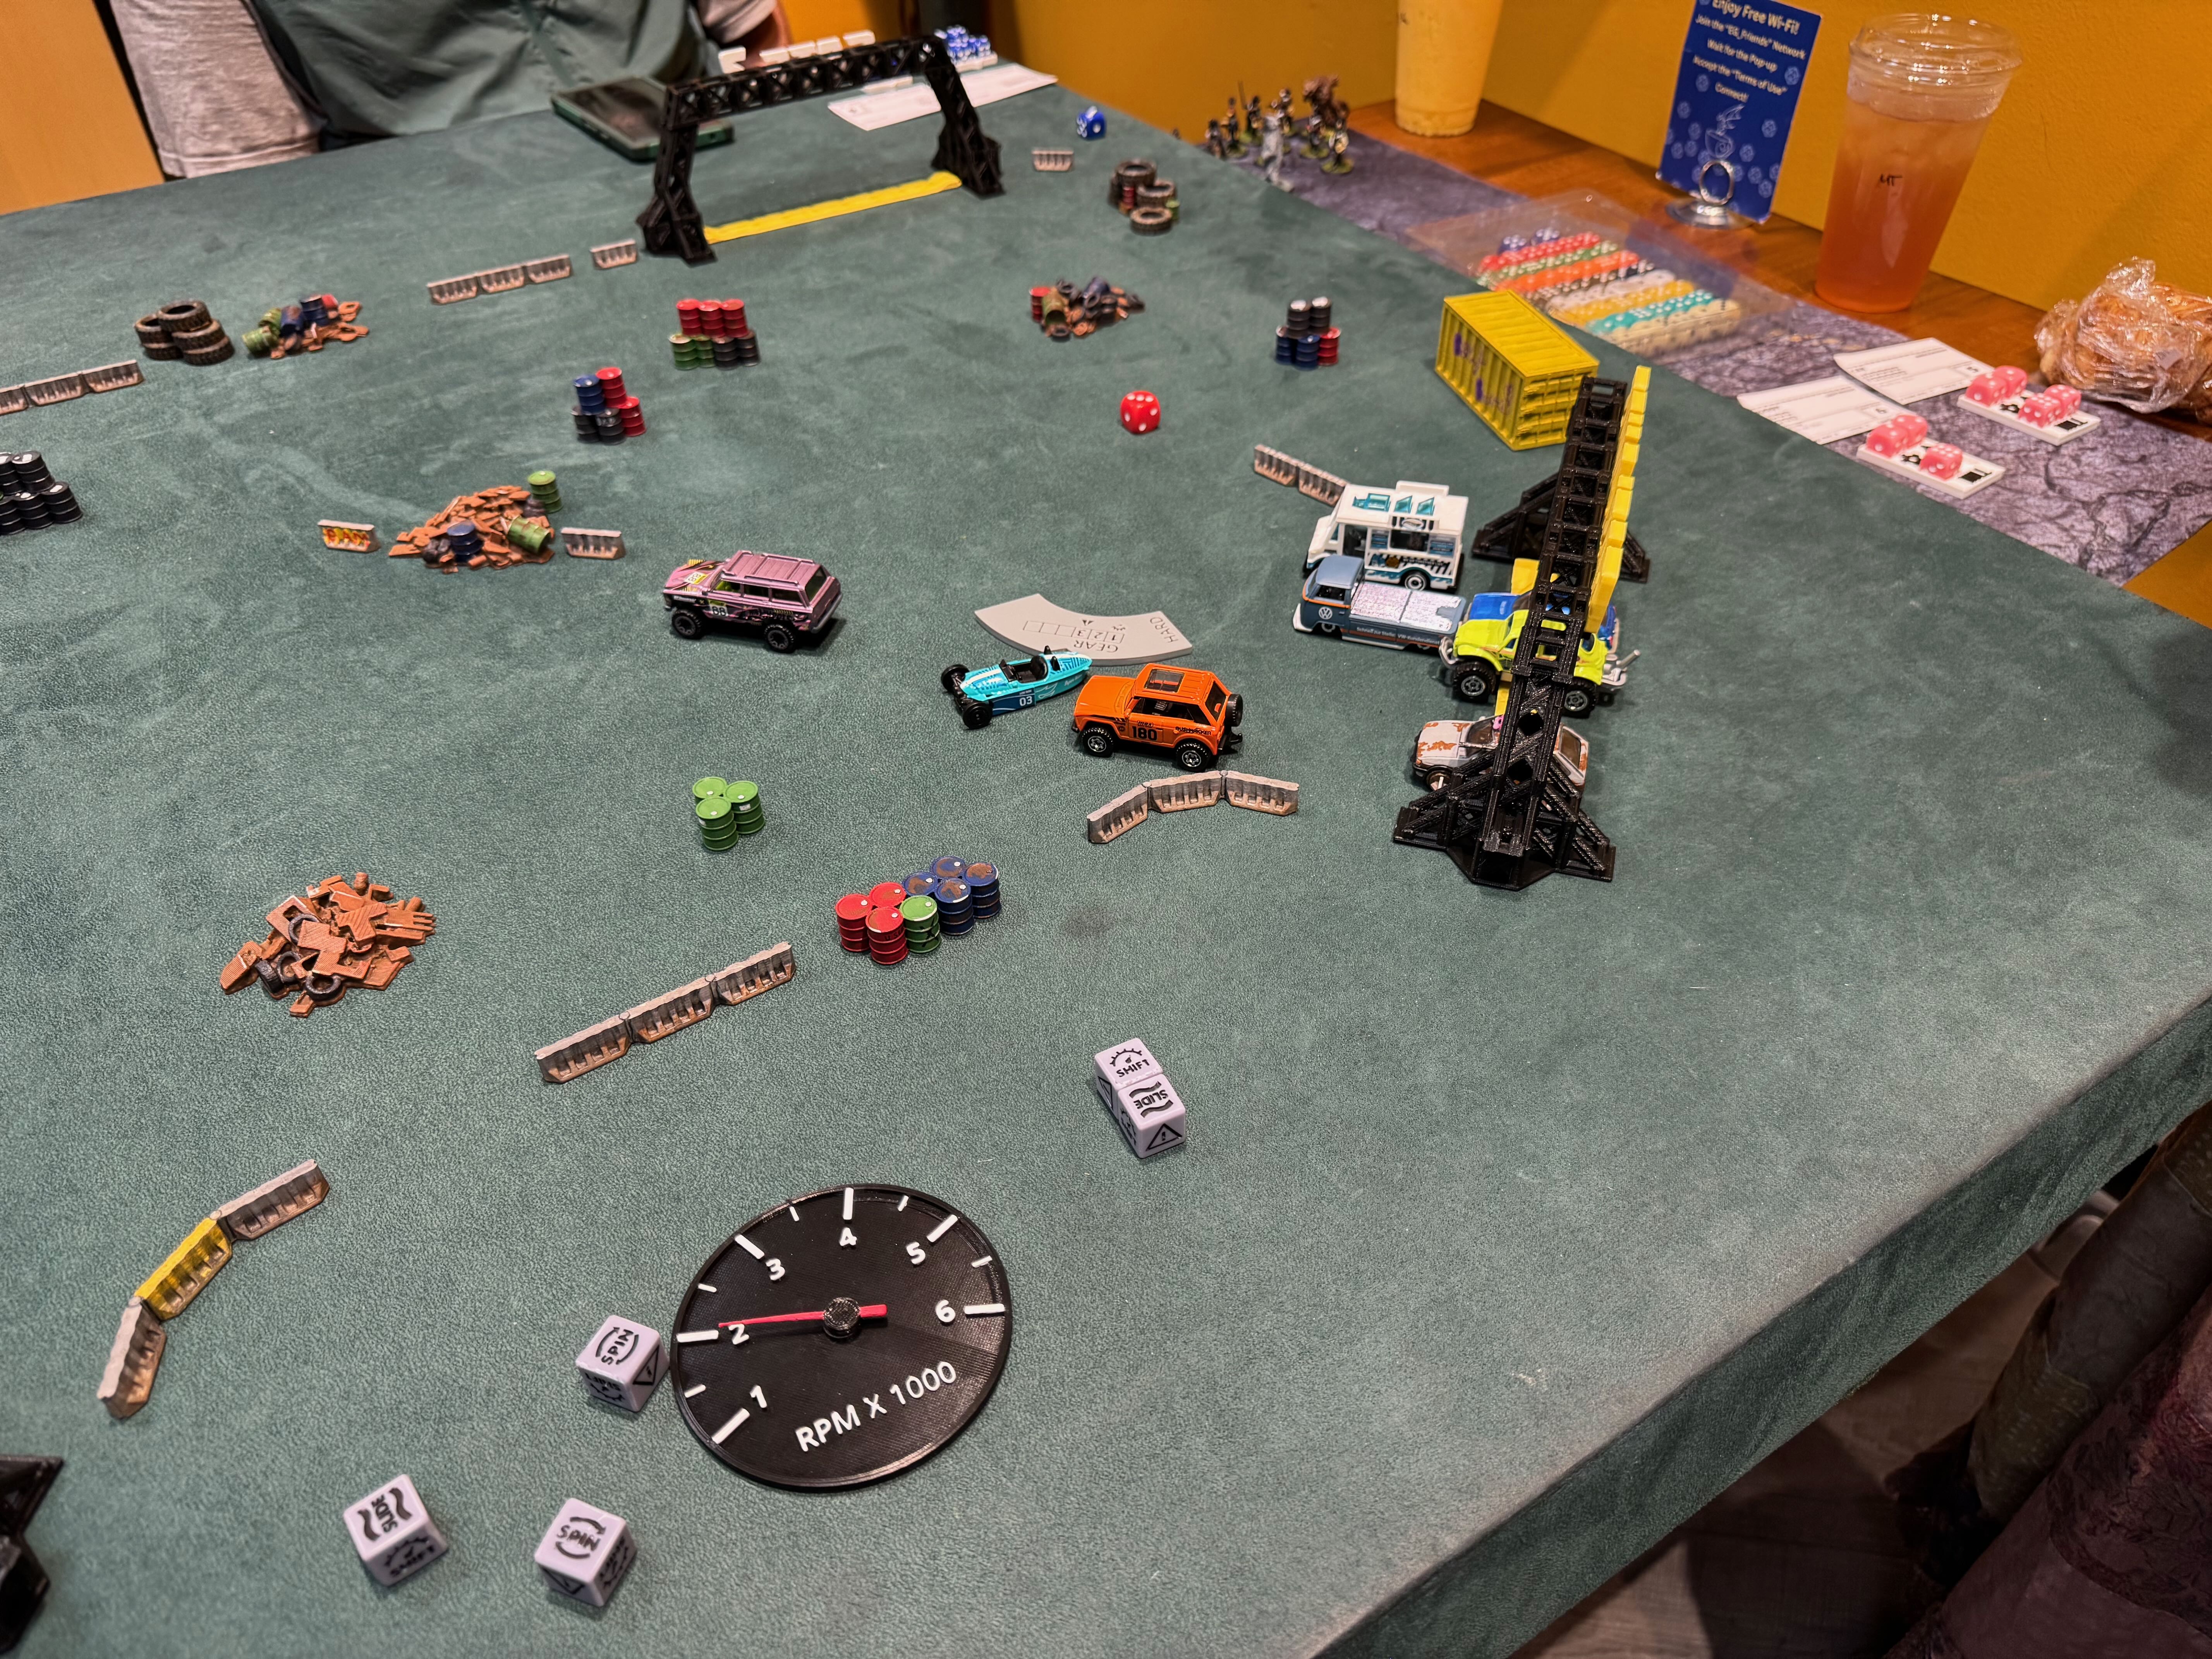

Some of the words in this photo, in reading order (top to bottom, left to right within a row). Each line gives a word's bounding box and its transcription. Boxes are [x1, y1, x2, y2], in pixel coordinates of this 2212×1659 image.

[1712, 0, 1742, 18] Enjoy
[1742, 4, 1767, 24] Free
[1767, 12, 1800, 35] Wi-Fi!
[1695, 14, 1712, 27] Join
[1711, 19, 1725, 32] the
[1772, 40, 1806, 60] Network
[1707, 38, 1724, 53] Wait
[1724, 43, 1736, 57] for
[1736, 49, 1749, 62] the
[1717, 64, 1731, 77] the
[1757, 79, 1769, 90] of
[712, 606, 727, 617] 88
[1094, 631, 1103, 639] 2
[1149, 617, 1179, 643] HARD
[1073, 639, 1118, 653] GEAR
[1019, 696, 1033, 707] 03
[1132, 725, 1157, 741] 180
[1116, 1059, 1150, 1077] SHIFT
[1133, 1089, 1169, 1109] SLIDE
[839, 1227, 857, 1249] 4
[906, 1242, 926, 1266] 5
[765, 1258, 785, 1280] 3
[935, 1299, 956, 1324] 6
[728, 1323, 750, 1345] 2
[601, 1329, 634, 1365] SPIN
[750, 1385, 768, 1408] 1
[795, 1404, 861, 1452] RPM
[890, 1361, 957, 1405] 1000
[371, 1494, 398, 1533] SLIDE
[556, 1524, 601, 1552] SPIN
